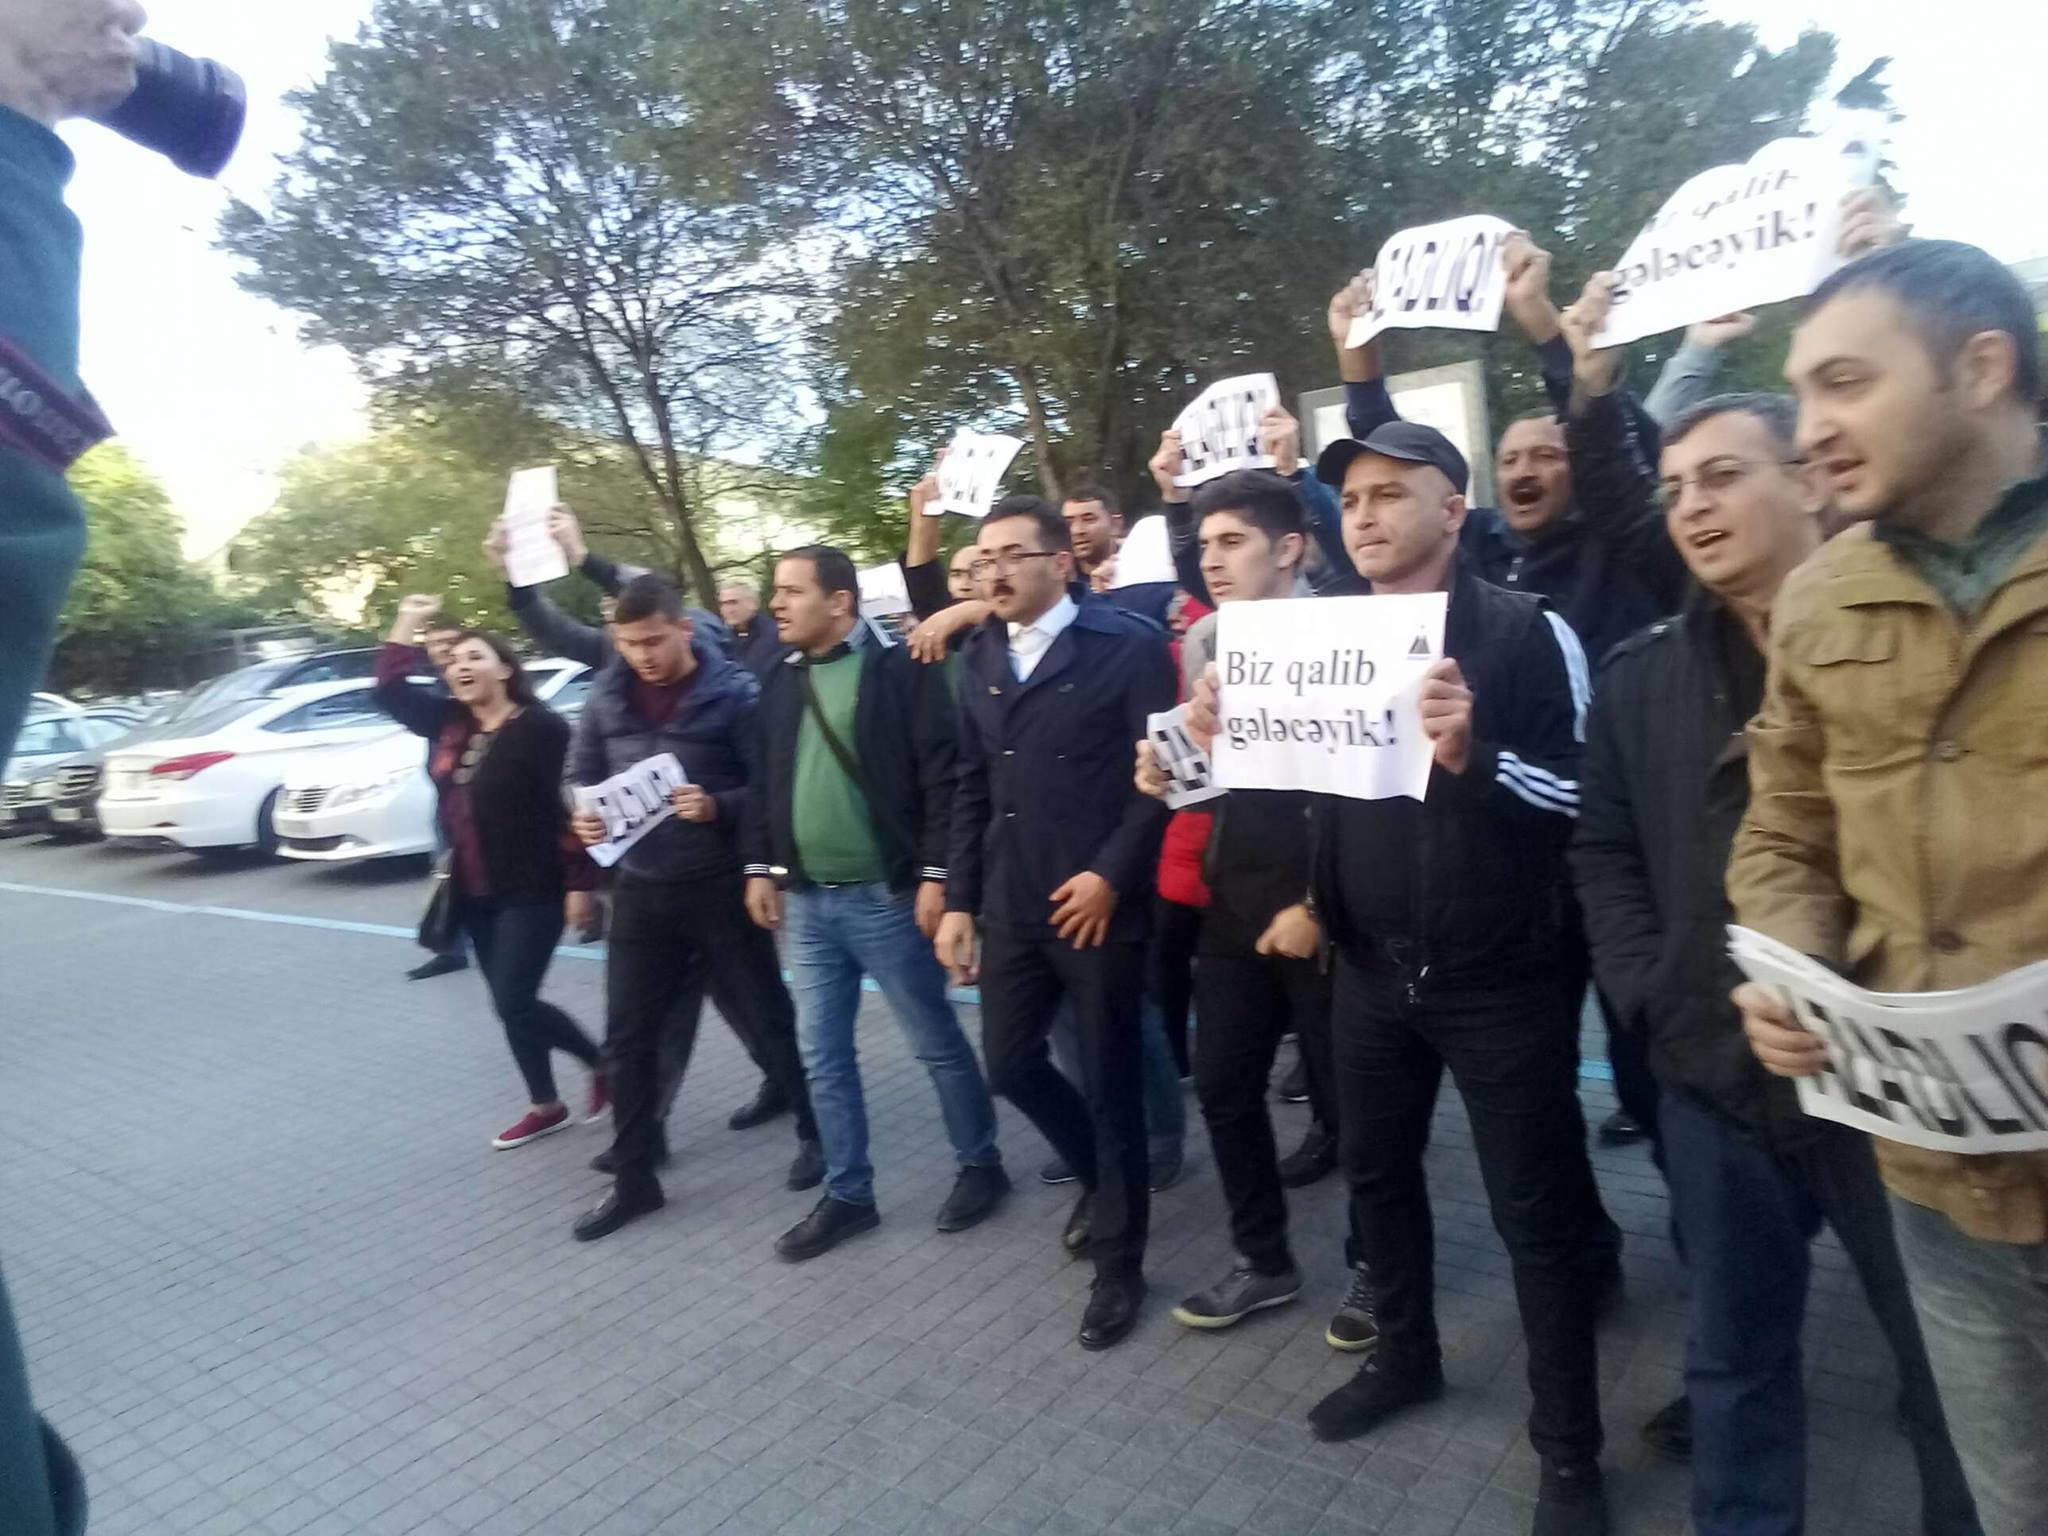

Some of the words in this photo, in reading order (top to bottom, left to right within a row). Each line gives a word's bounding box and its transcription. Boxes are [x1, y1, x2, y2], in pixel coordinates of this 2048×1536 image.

[1225, 650, 1272, 686] Biz
[1286, 649, 1376, 696] qalib
[1227, 707, 1400, 754] gələcəyik!
